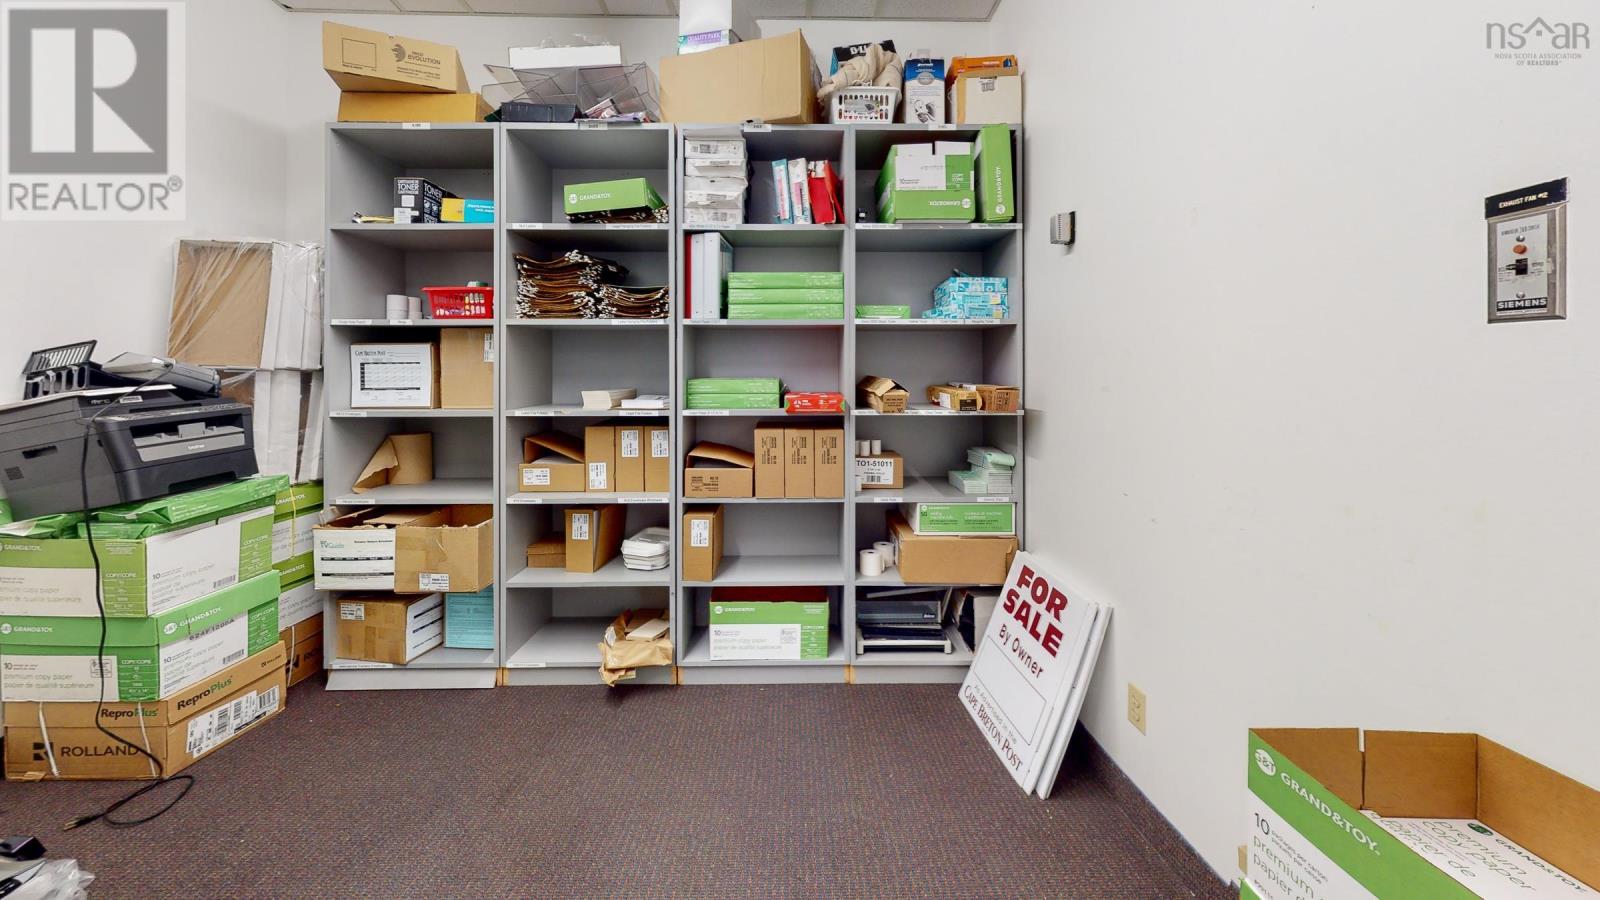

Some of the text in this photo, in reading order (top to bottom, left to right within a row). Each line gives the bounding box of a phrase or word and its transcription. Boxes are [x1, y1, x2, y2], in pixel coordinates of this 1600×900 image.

[398, 183, 419, 191] TONER
[424, 183, 443, 199] TONER
[1499, 198, 1524, 209] EXHAUST
[1524, 194, 1537, 203] FAN
[1498, 299, 1547, 309] SIEMENS
[1017, 565, 1068, 622] FOR
[1003, 588, 1064, 658] SALE
[999, 624, 1044, 678] By Owner
[4, 662, 13, 670] 10
[964, 684, 1024, 772] CAPE BRETON POST
[61, 745, 141, 758] ROLLAND
[1254, 812, 1270, 836] 10
[1253, 835, 1314, 899] premium
[1253, 853, 1292, 896] papier
[1447, 859, 1477, 879] de
[1466, 851, 1538, 893] paper
